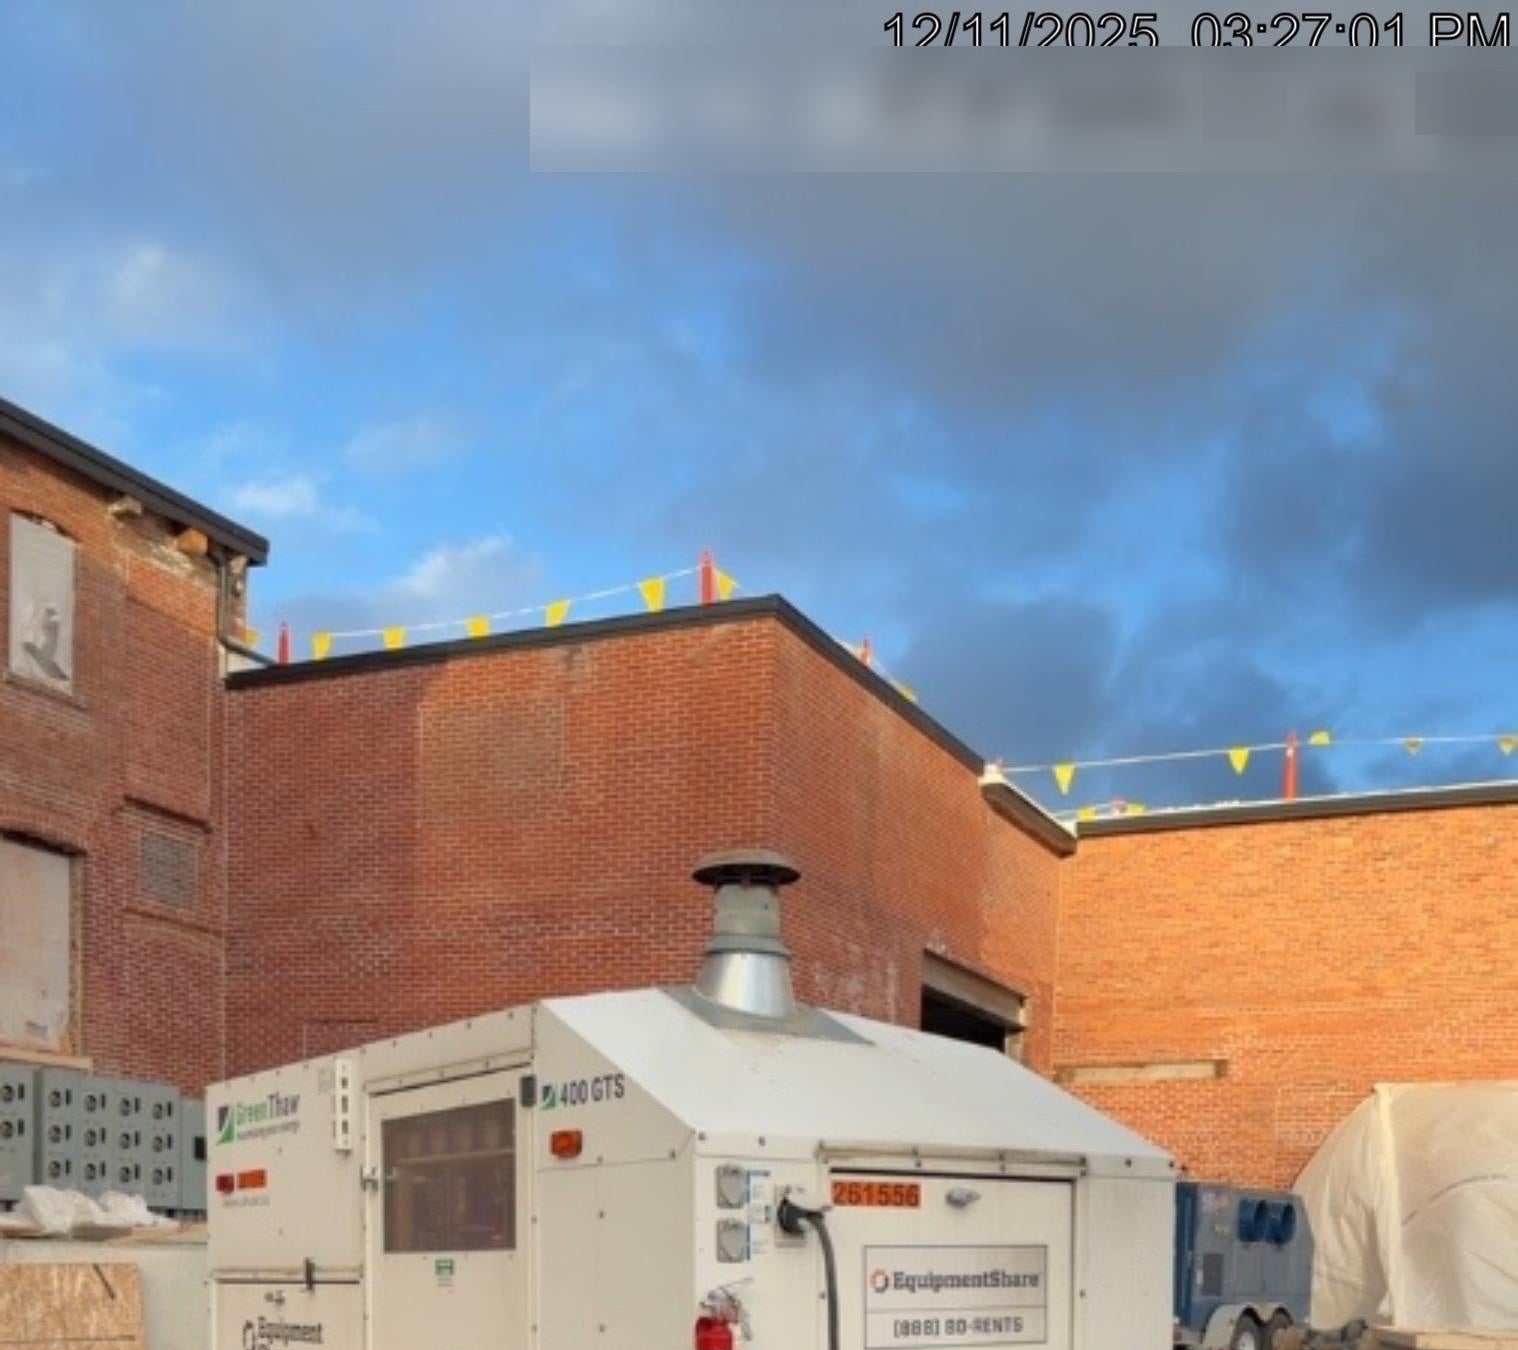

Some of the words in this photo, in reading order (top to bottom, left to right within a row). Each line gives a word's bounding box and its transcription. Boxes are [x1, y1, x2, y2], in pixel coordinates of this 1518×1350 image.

[560, 1080, 588, 1107] 400
[591, 1073, 625, 1102] GTS
[833, 1182, 920, 1206] 261556
[893, 1269, 1040, 1294] EquipmentShare
[257, 1316, 323, 1346] Equipment
[944, 1316, 1023, 1336] 80-RENTS
